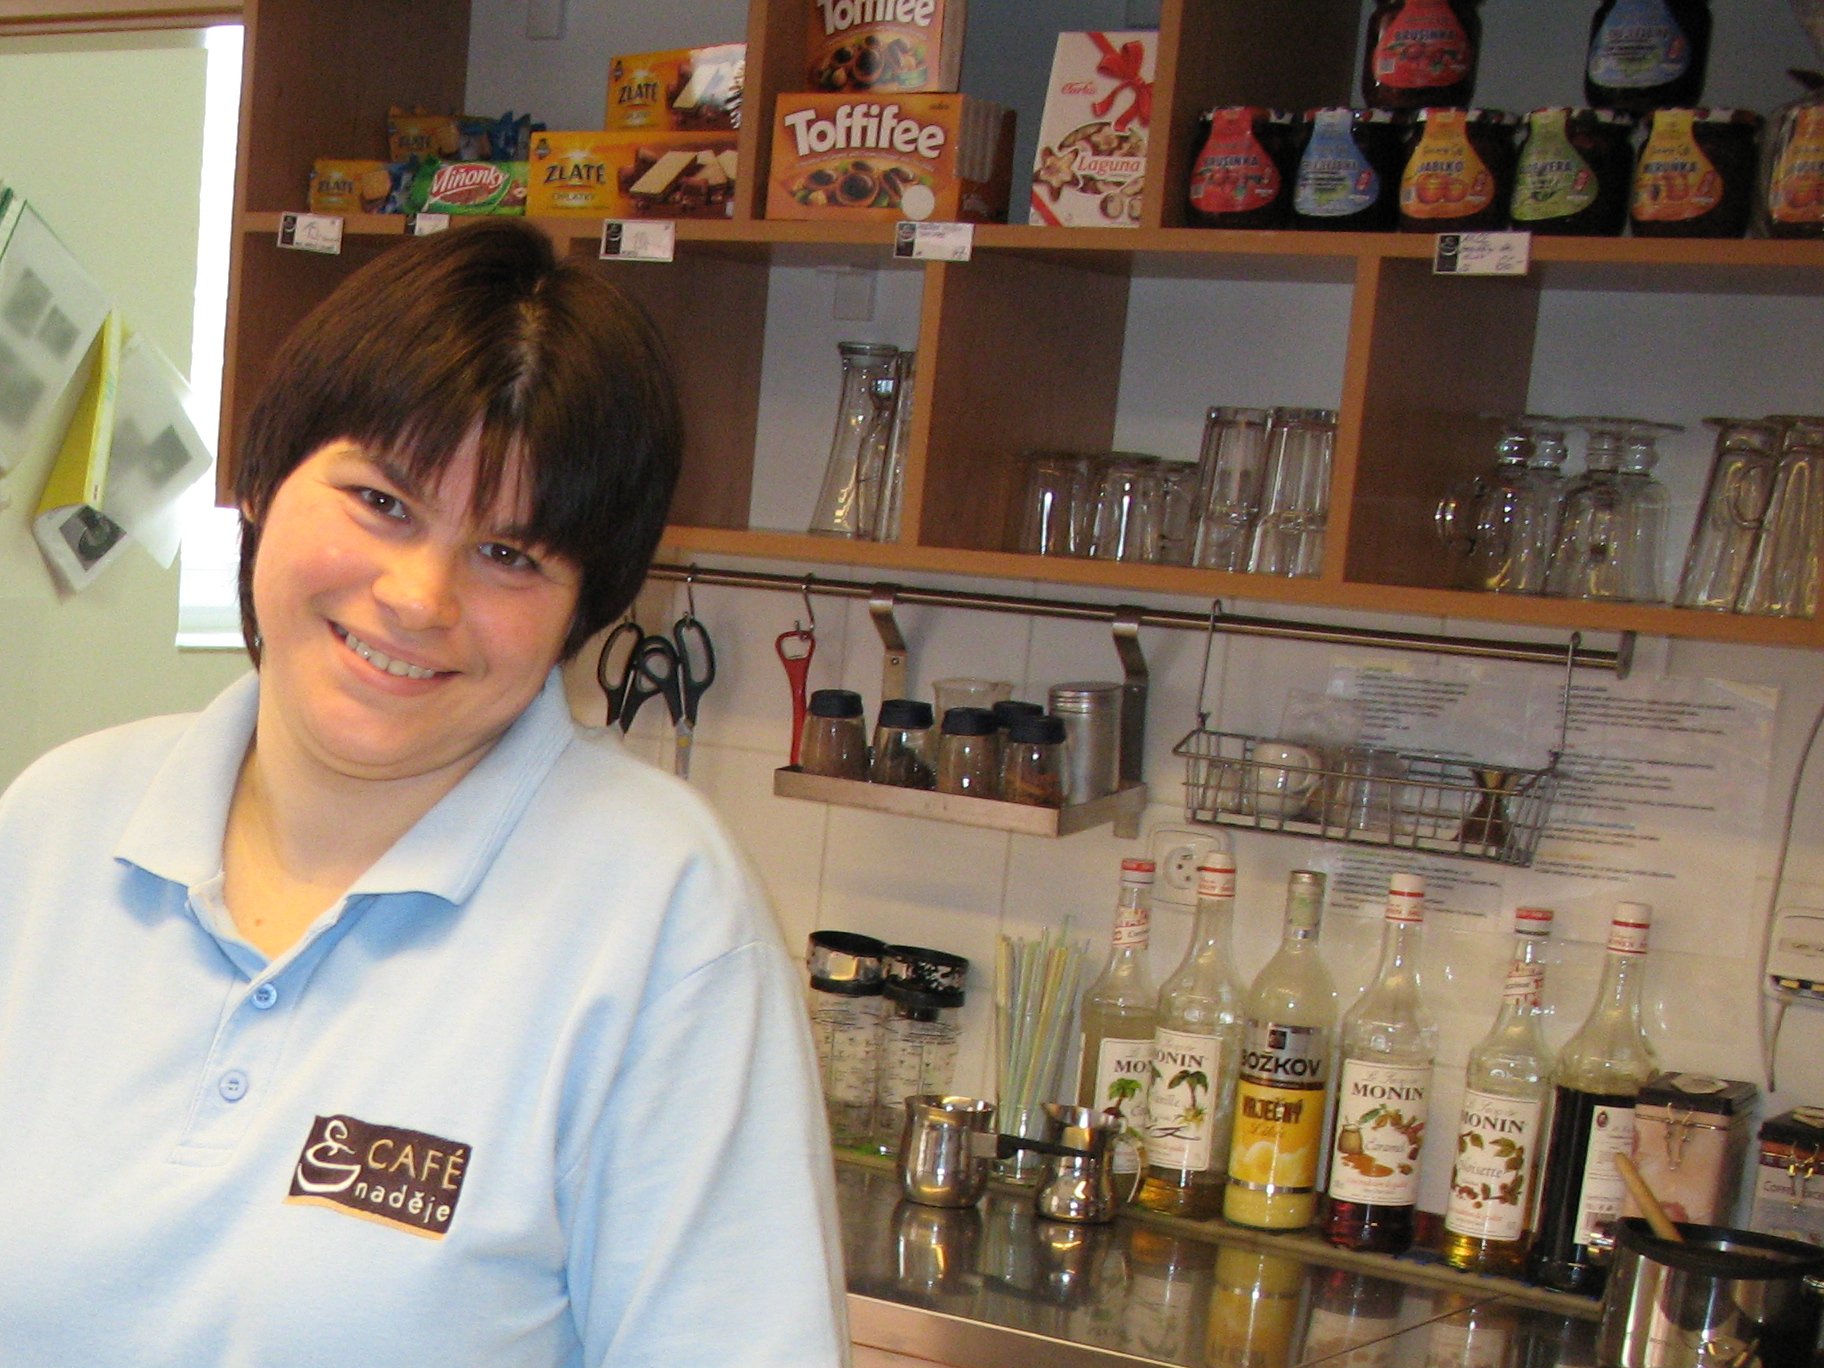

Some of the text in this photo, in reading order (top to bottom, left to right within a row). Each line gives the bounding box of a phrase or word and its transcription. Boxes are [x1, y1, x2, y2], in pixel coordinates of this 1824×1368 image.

[784, 103, 946, 159] Toffifee
[1077, 155, 1142, 180] Laguna
[1352, 1082, 1425, 1101] MONIN
[367, 1138, 465, 1190] CAFÉ
[354, 1182, 452, 1224] naděje
